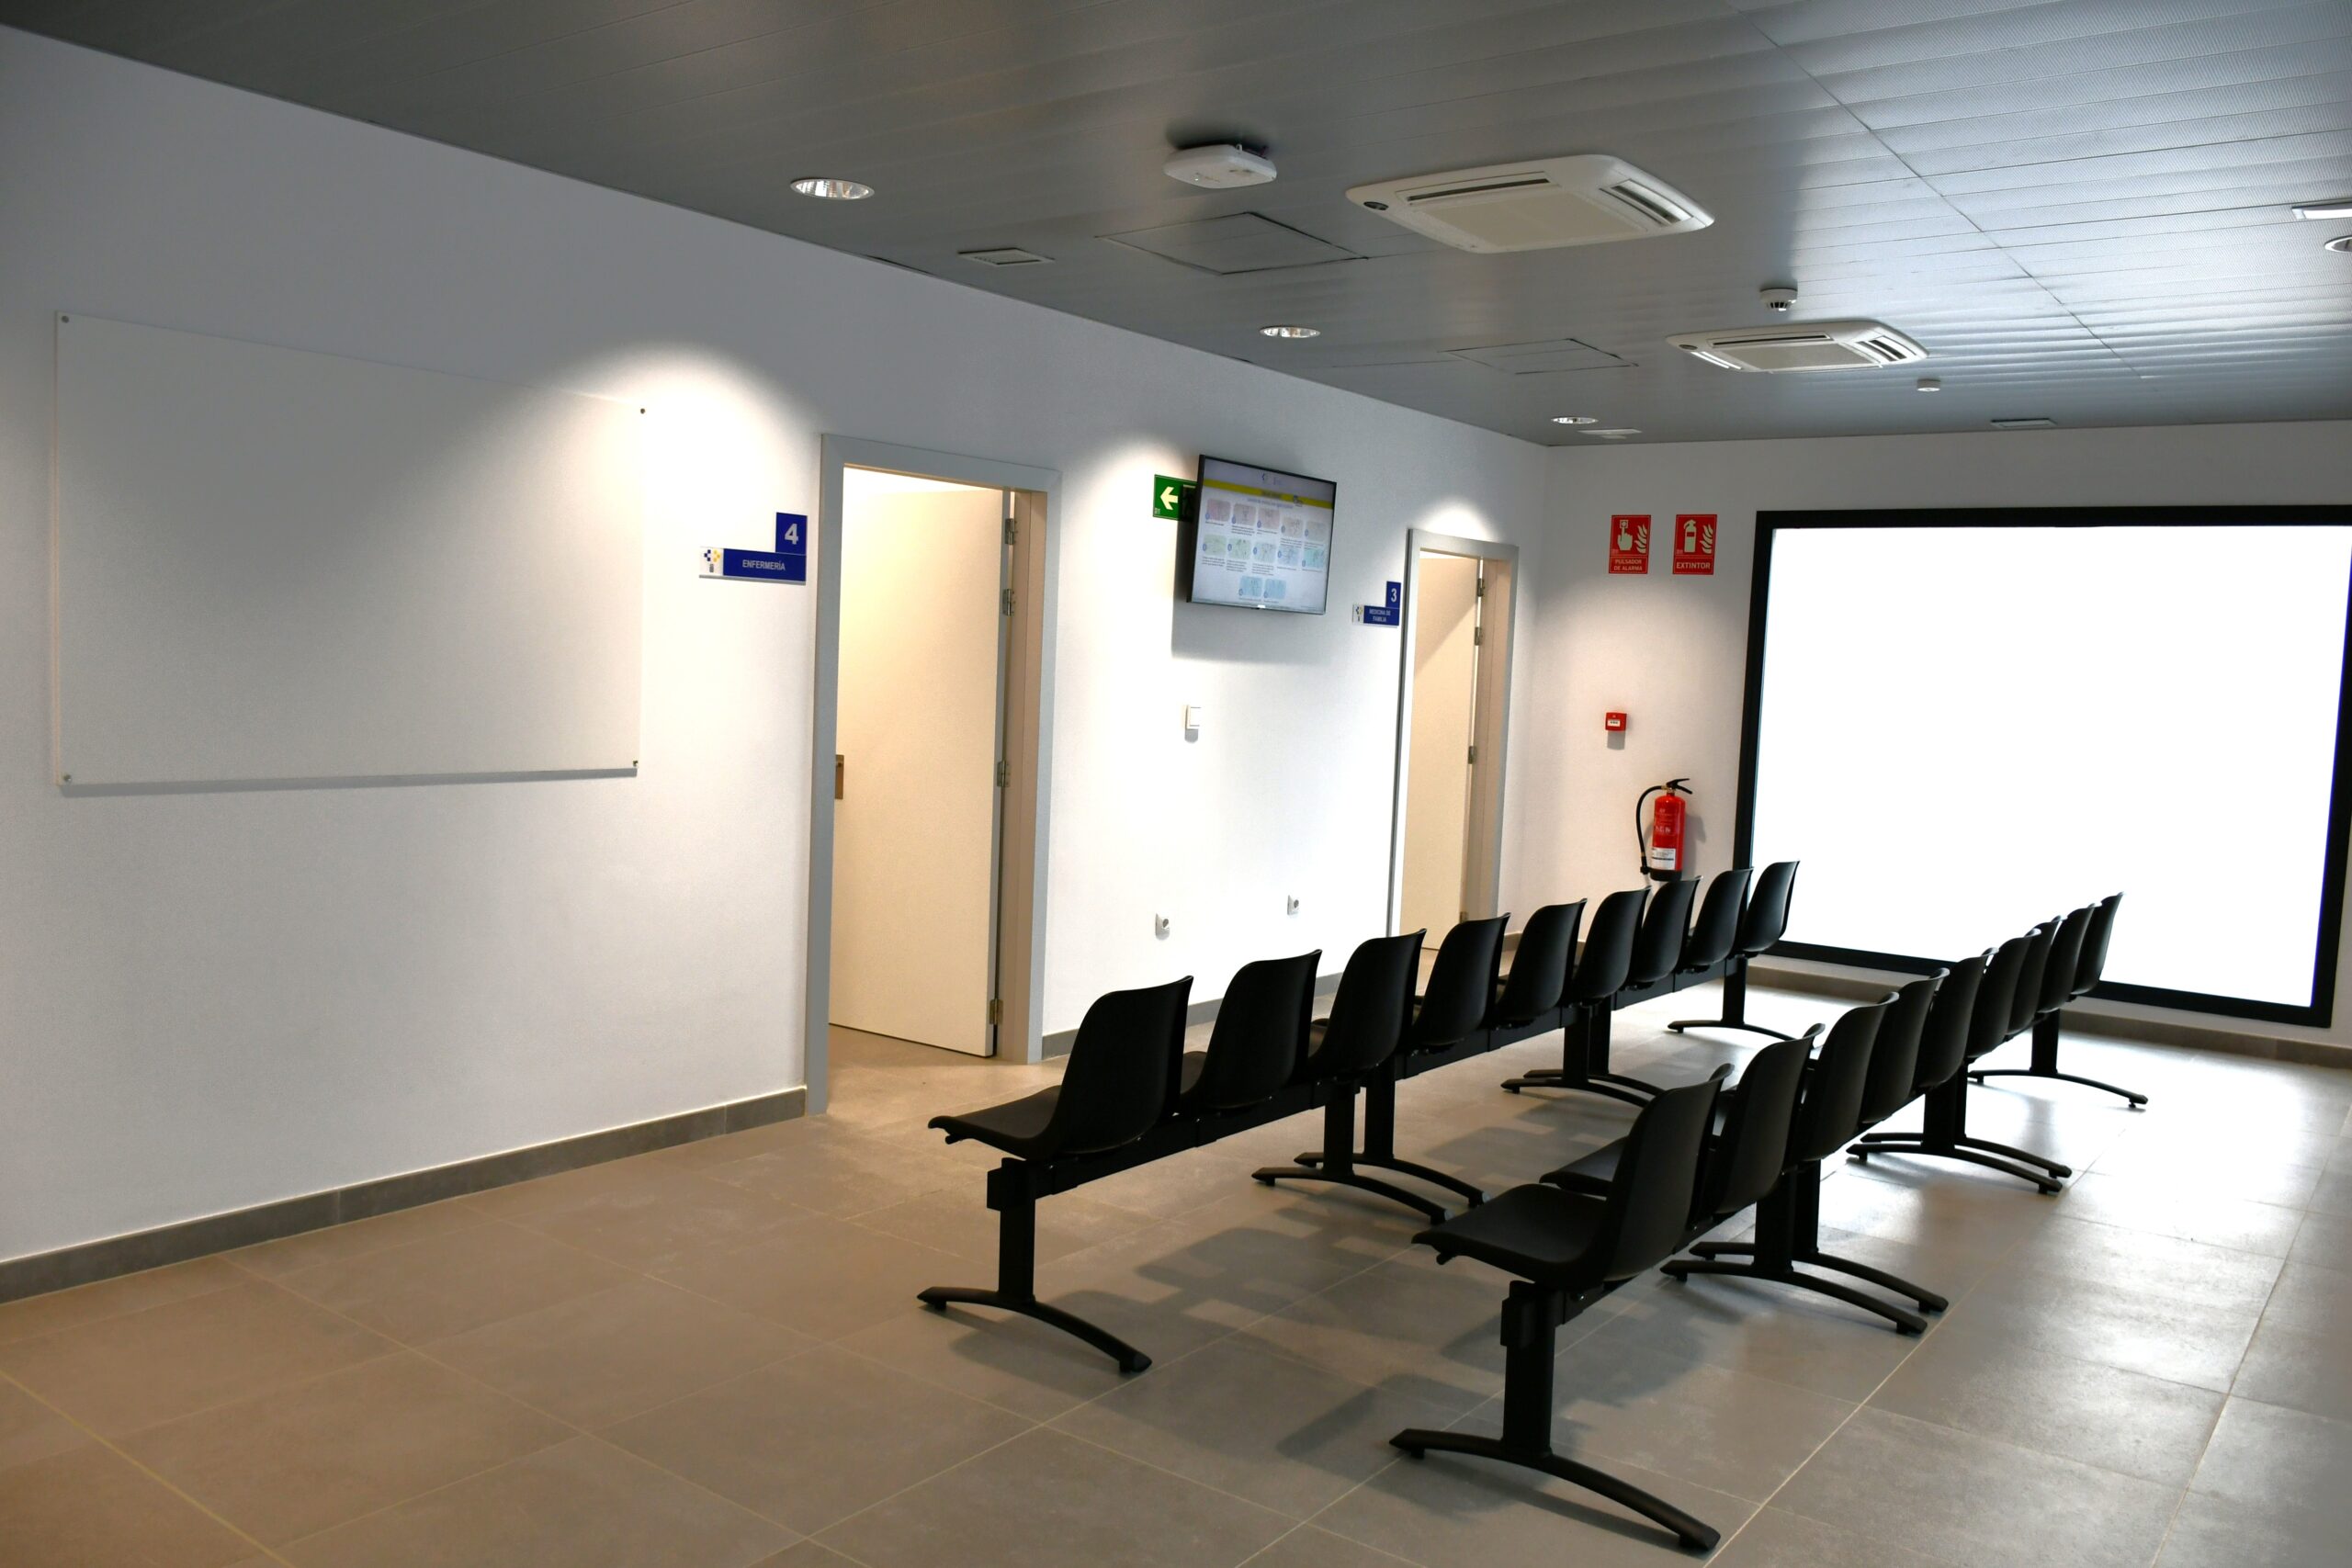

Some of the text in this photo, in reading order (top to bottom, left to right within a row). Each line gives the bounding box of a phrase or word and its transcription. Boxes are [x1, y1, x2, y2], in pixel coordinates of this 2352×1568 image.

[785, 523, 799, 545] 4
[742, 559, 786, 571] ENFERMERÍA
[1676, 561, 1711, 570] EXTINTOR
[1390, 588, 1397, 603] 3
